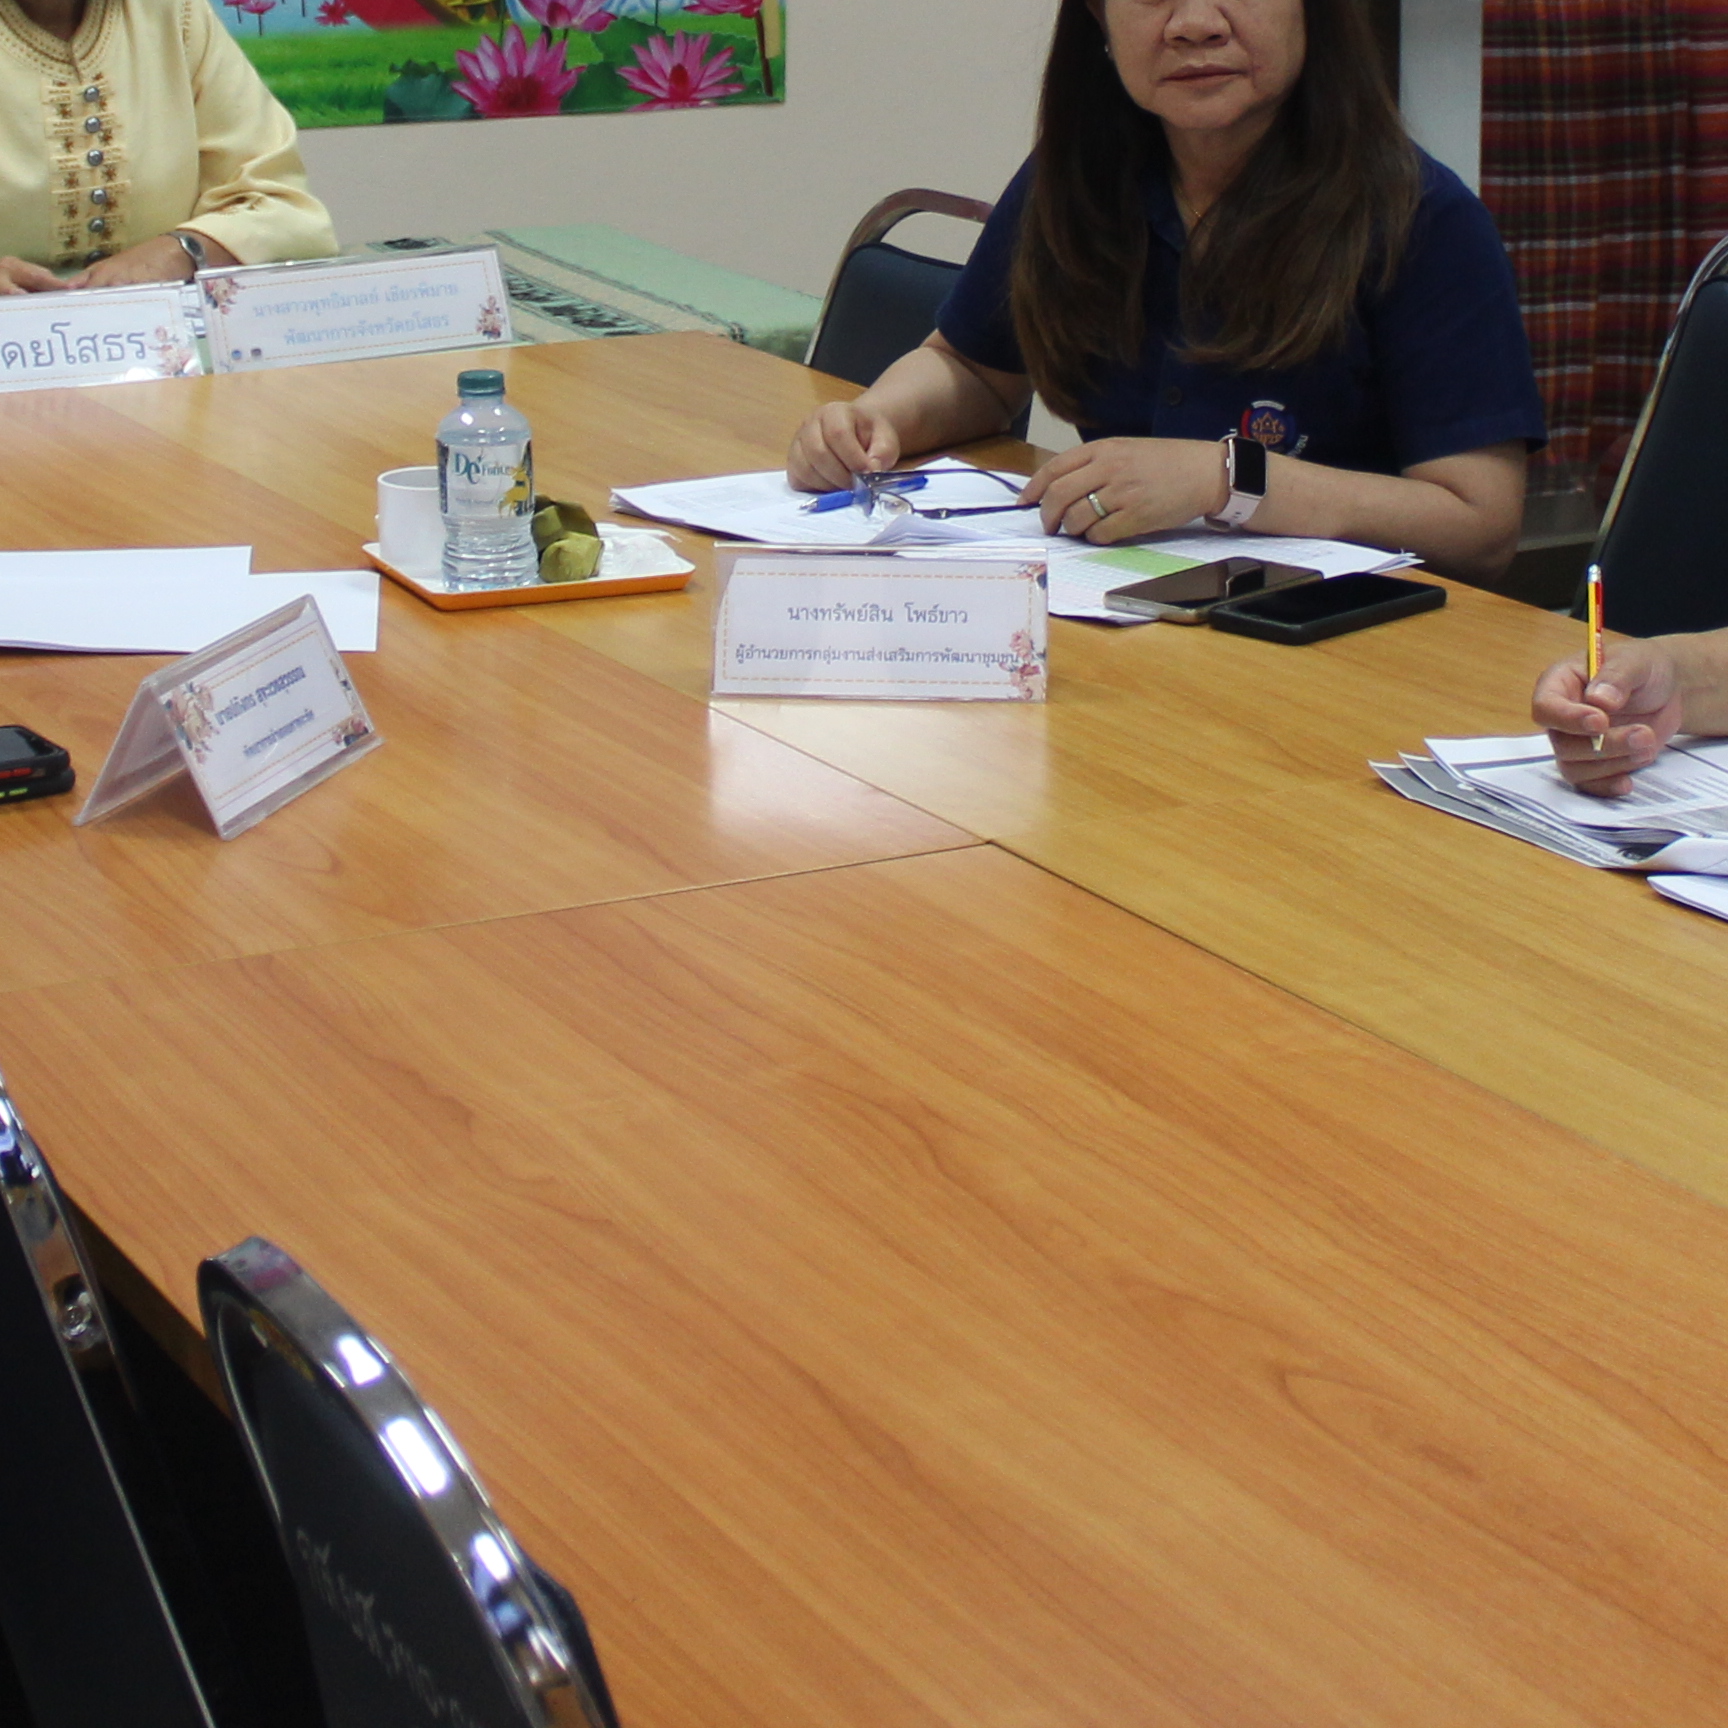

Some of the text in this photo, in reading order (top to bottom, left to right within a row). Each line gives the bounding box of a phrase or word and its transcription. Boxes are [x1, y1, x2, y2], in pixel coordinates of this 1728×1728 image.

[787, 602, 894, 623] นางทรัพย์สิน
